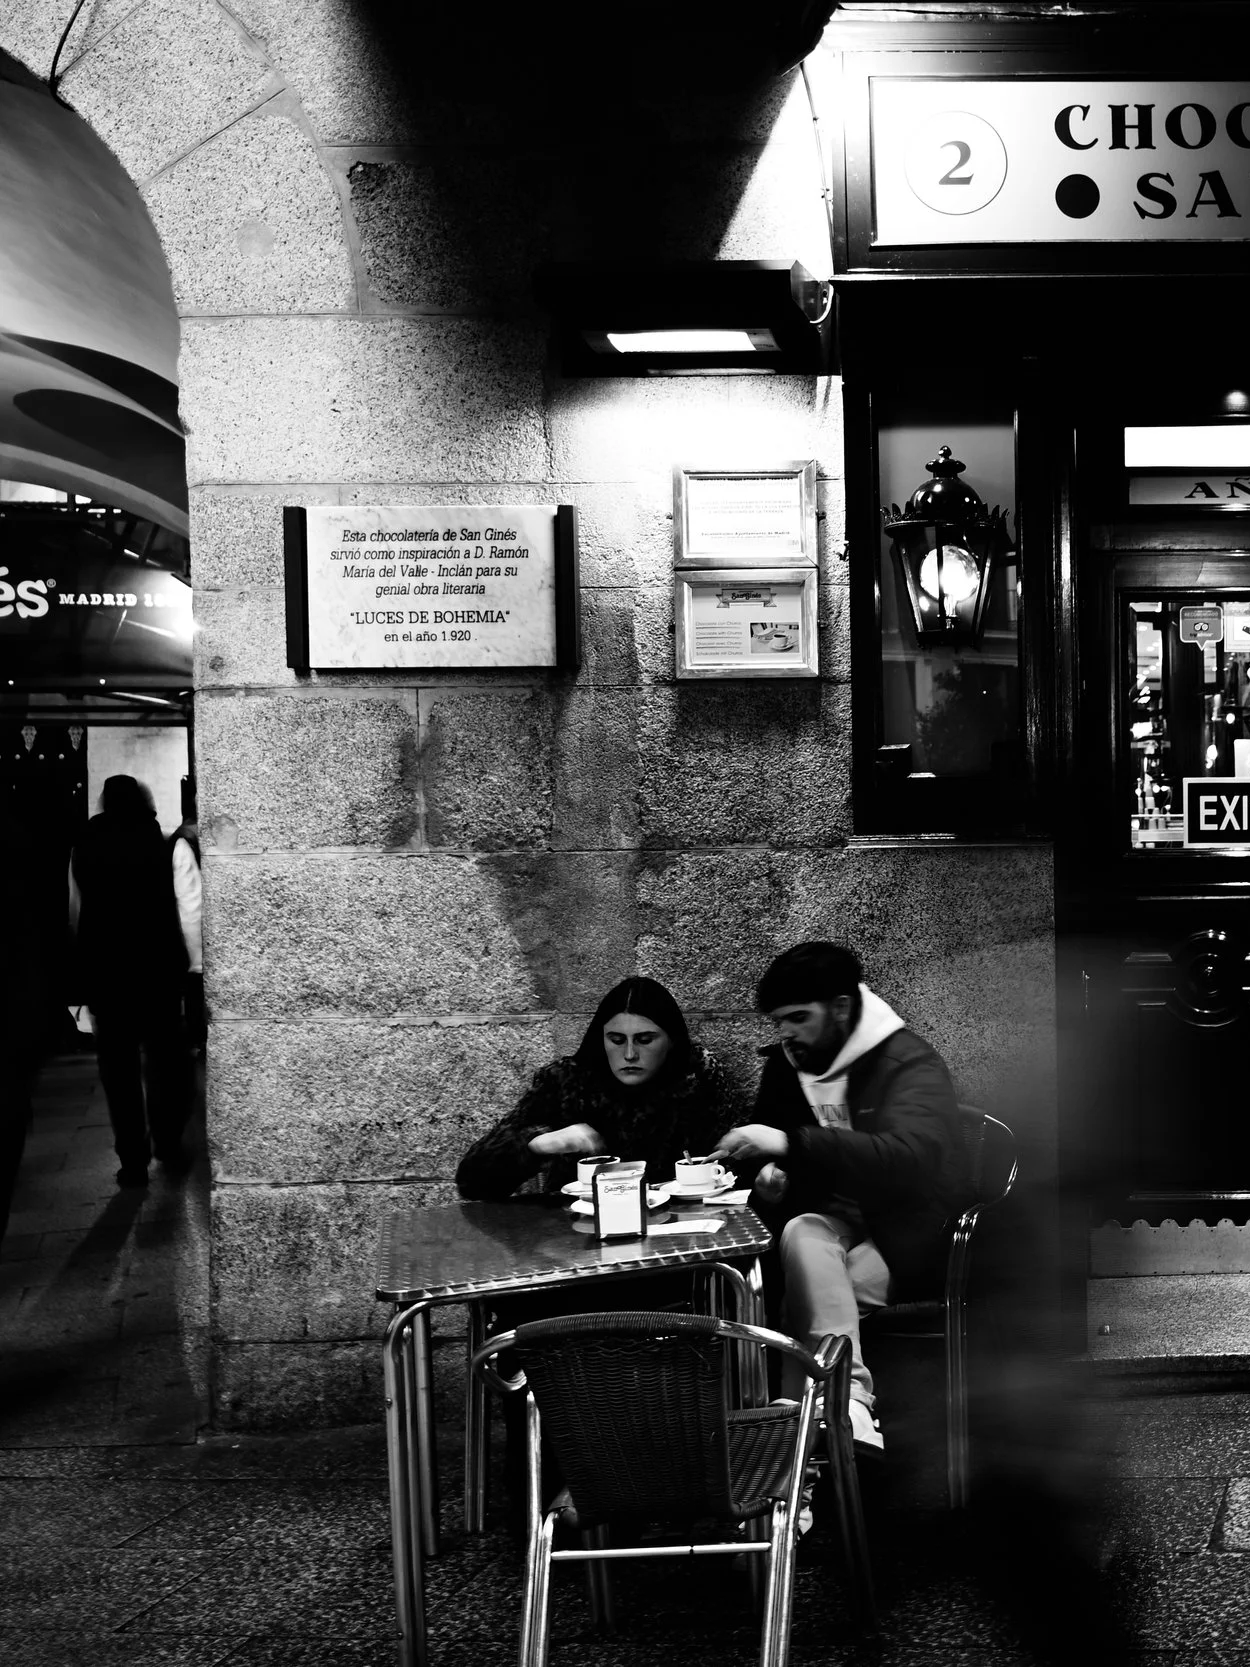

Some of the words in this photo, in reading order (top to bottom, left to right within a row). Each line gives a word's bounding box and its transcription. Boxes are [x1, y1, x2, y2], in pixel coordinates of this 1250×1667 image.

[938, 141, 975, 185] 2
[342, 529, 367, 543] Esta
[369, 528, 440, 542] chocolatería
[442, 528, 458, 542] de
[459, 527, 481, 542] San
[484, 527, 517, 541] Ginés
[330, 547, 361, 560] sirvió
[363, 550, 396, 560] como
[398, 545, 461, 563] inspiración
[463, 549, 471, 560] a
[473, 545, 486, 559] D.
[488, 545, 529, 559] Ramón
[342, 565, 375, 578] María
[378, 565, 397, 578] del
[400, 564, 429, 578] Valle
[437, 563, 473, 577] Inclán
[474, 566, 502, 580] para
[503, 566, 518, 577] su
[375, 582, 411, 599] genial
[413, 582, 440, 596] obra
[442, 582, 486, 595] literaria
[58, 593, 139, 607] MADRID
[408, 610, 429, 624] DE
[384, 633, 399, 642] en
[402, 631, 413, 642] el
[415, 630, 438, 642] año
